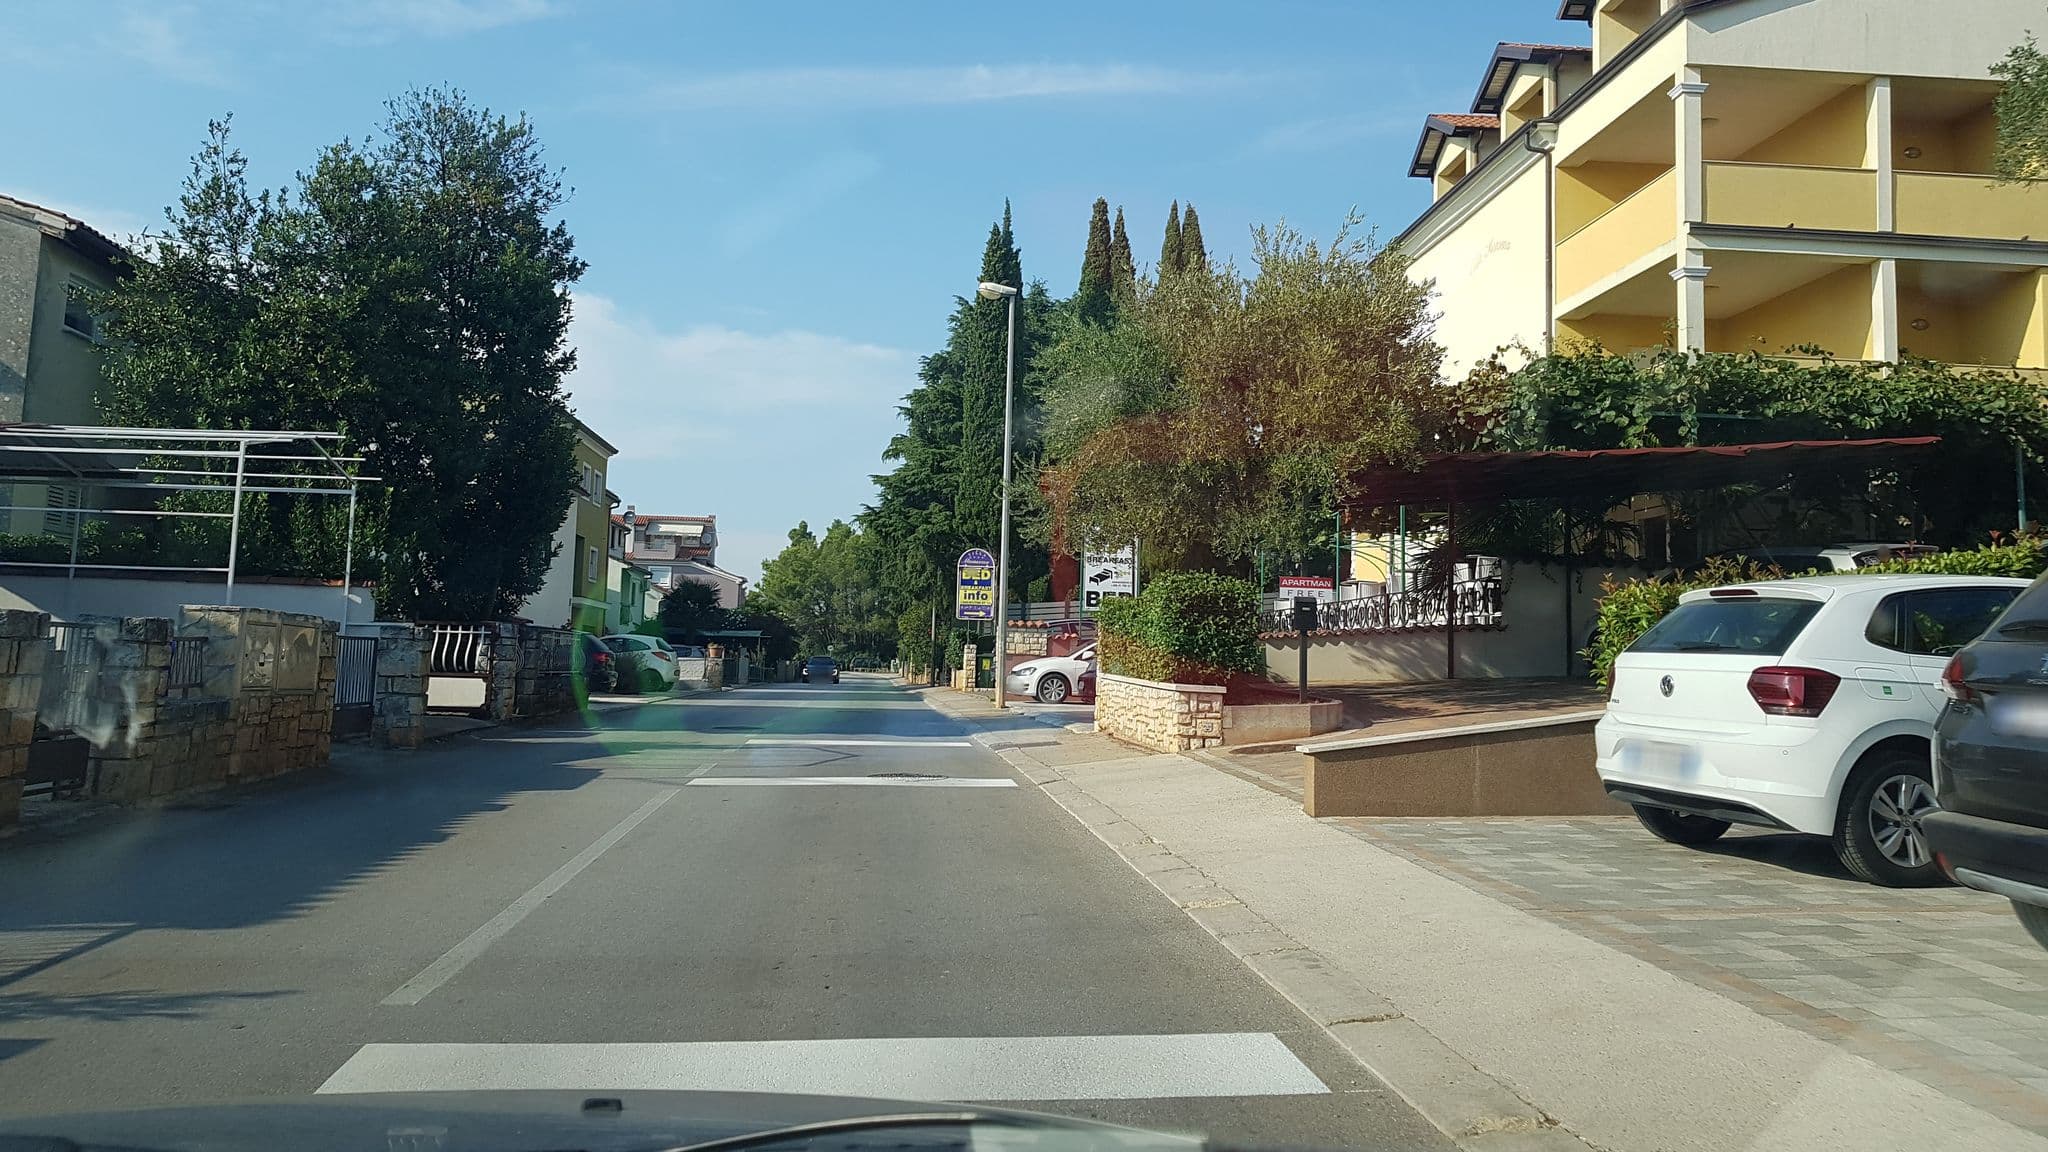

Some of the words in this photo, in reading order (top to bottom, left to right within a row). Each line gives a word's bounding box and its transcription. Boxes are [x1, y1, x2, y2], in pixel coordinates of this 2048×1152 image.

[1281, 579, 1331, 587] APARTMAN
[963, 590, 988, 601] info
[1287, 590, 1325, 598] FREE
